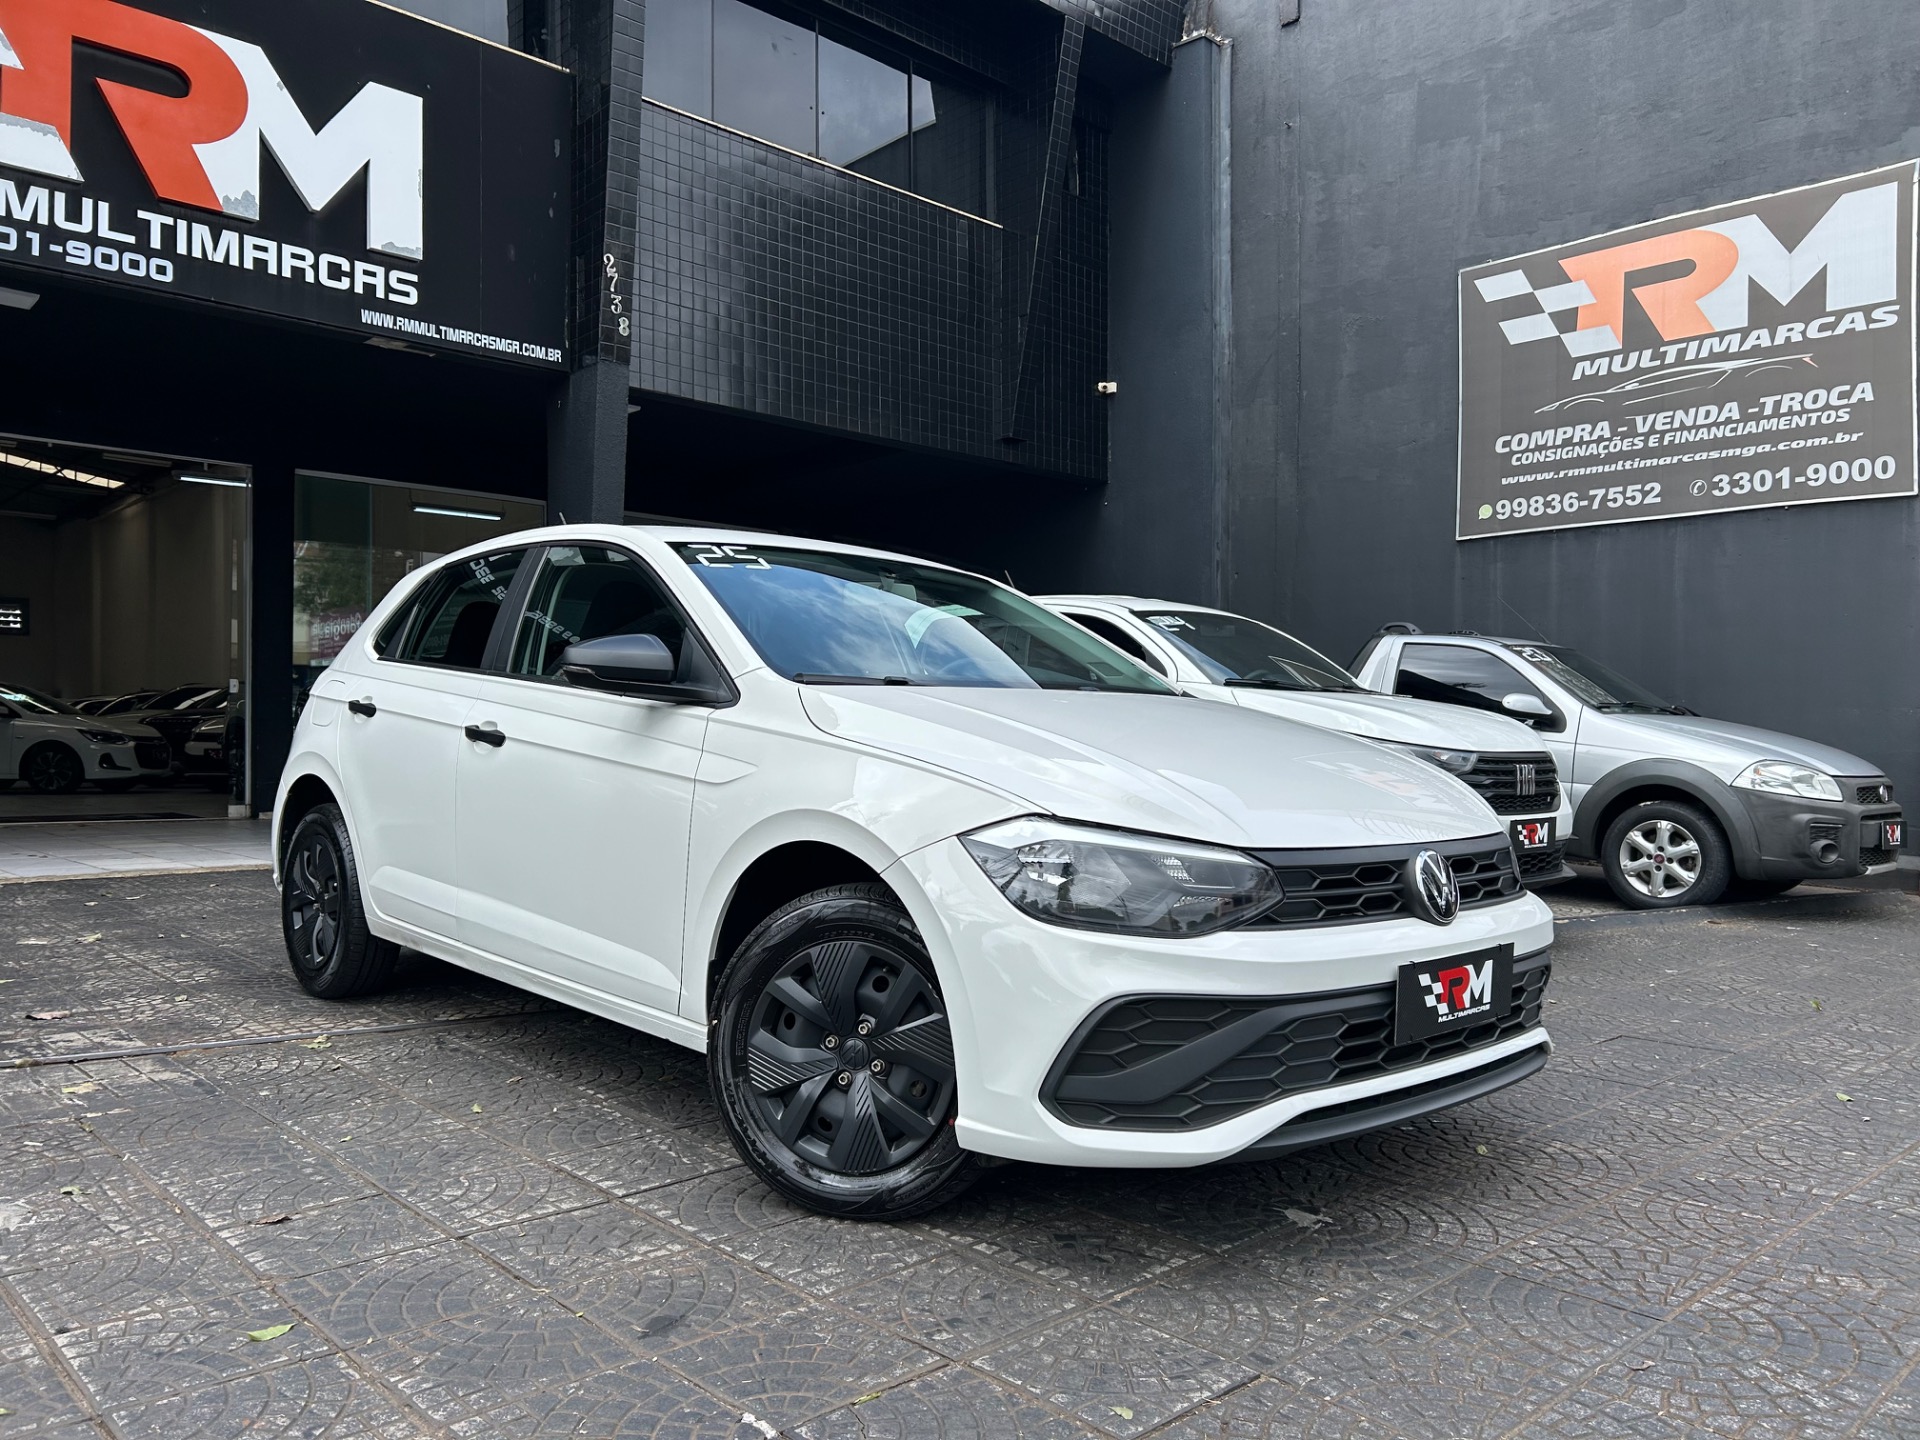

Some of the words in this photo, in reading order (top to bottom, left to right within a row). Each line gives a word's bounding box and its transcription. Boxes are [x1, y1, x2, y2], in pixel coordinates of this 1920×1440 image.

[0, 178, 420, 306] MULTIMARCAS
[1558, 181, 1899, 346] RM
[603, 253, 630, 337] 2738
[360, 308, 562, 363] WWW.RMMULTIMARCASMGA.COM.BR
[1572, 305, 1901, 381] MULTIMARCAS
[1495, 420, 1612, 454] COMPRA
[1633, 402, 1741, 434] VENDA
[1511, 435, 1645, 466] CONSIGNAÇÕES
[1648, 434, 1660, 448] E
[1663, 407, 1851, 446] FINANCIAMENTOS
[1501, 431, 1865, 486] www.rmmultimarcasmga.com.br
[1711, 455, 1896, 497] 3301-9000
[1495, 482, 1662, 520] 99836-7552
[687, 544, 773, 570] 25
[1437, 959, 1494, 1010] RM
[1437, 1003, 1491, 1023] MULTIMARCAS
